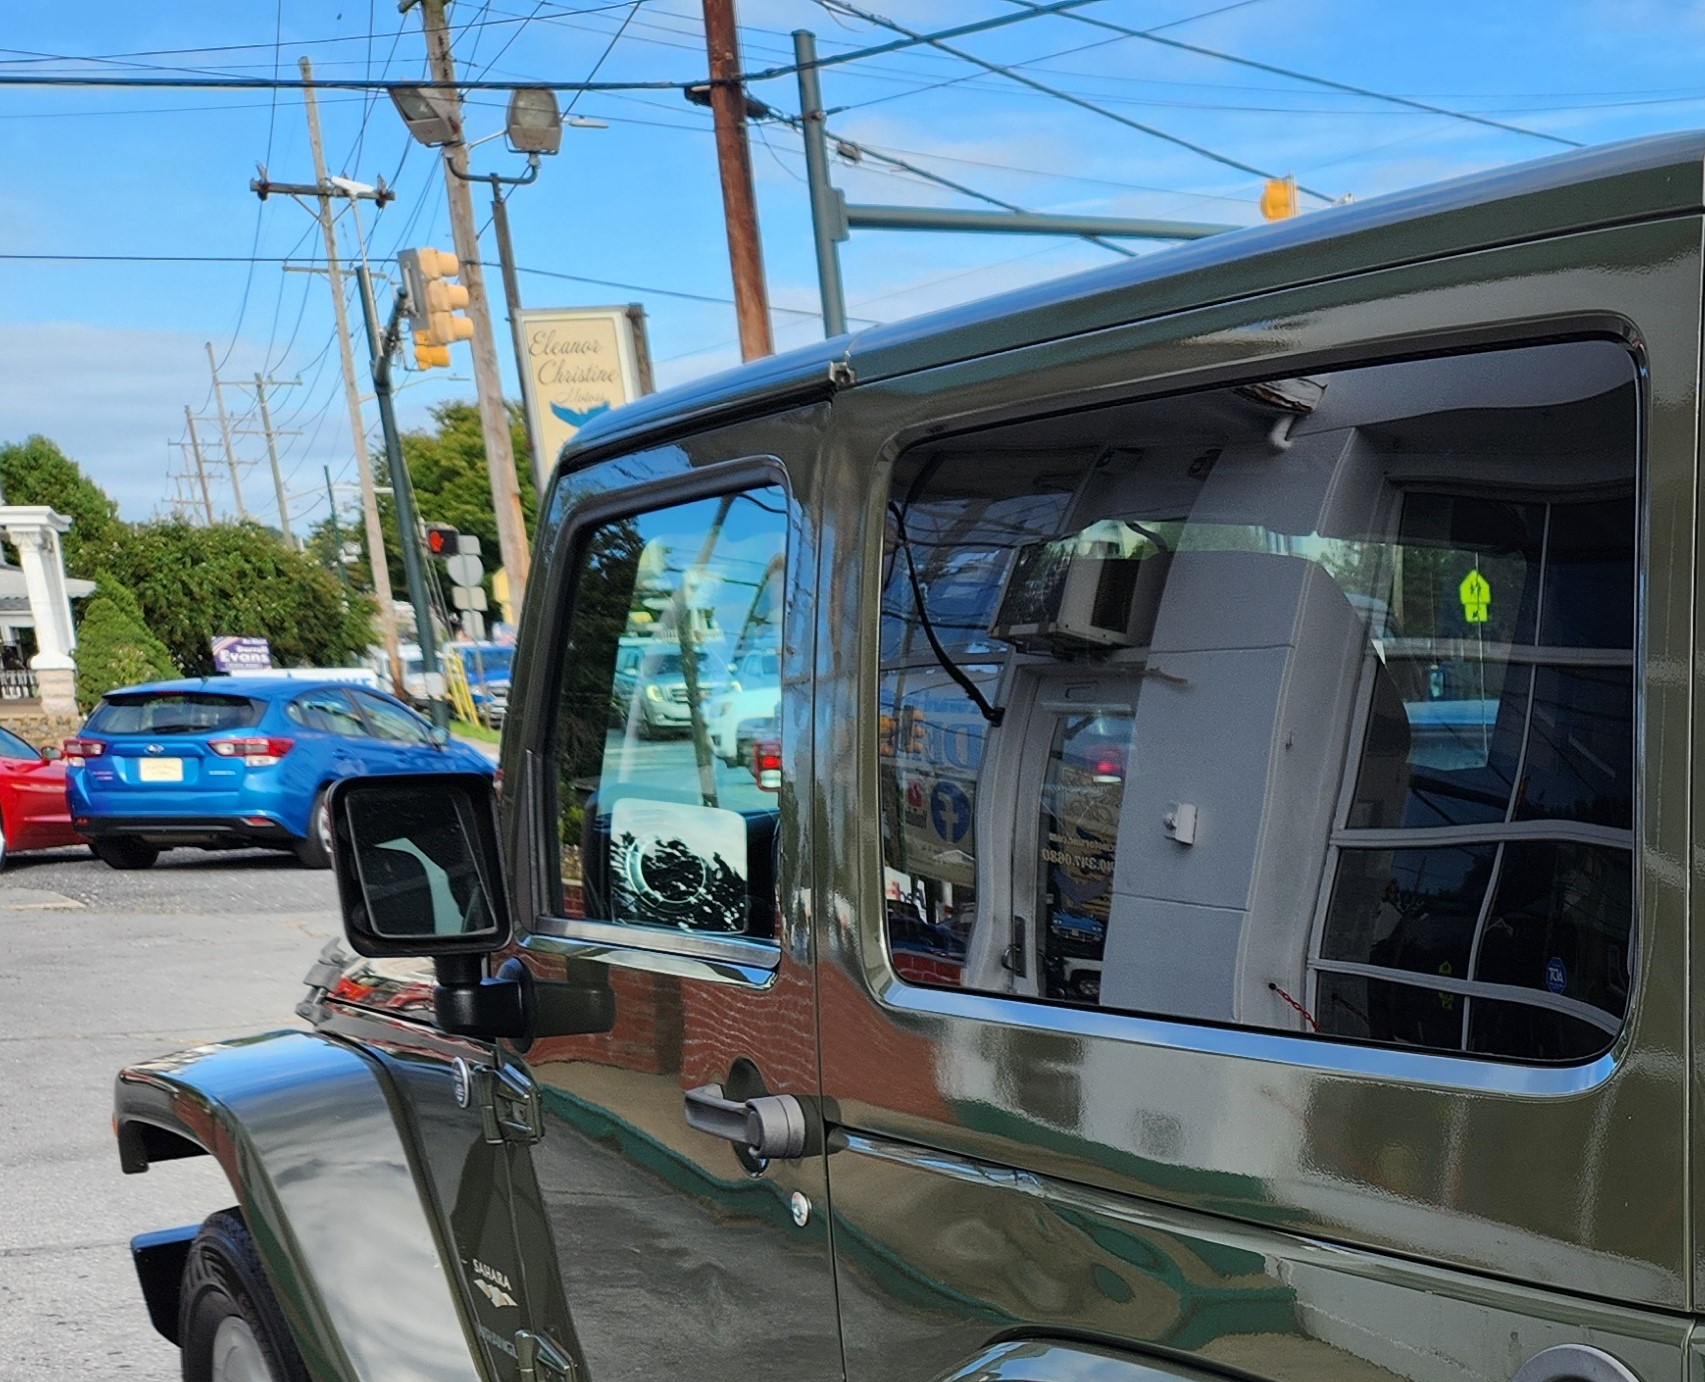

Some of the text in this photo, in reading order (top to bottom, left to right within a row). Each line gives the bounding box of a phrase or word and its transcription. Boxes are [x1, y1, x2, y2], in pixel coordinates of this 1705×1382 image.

[529, 329, 600, 357] Eleanor
[538, 359, 617, 386] Christine
[220, 649, 271, 664] Evans
[472, 1258, 512, 1291] SAHARA
